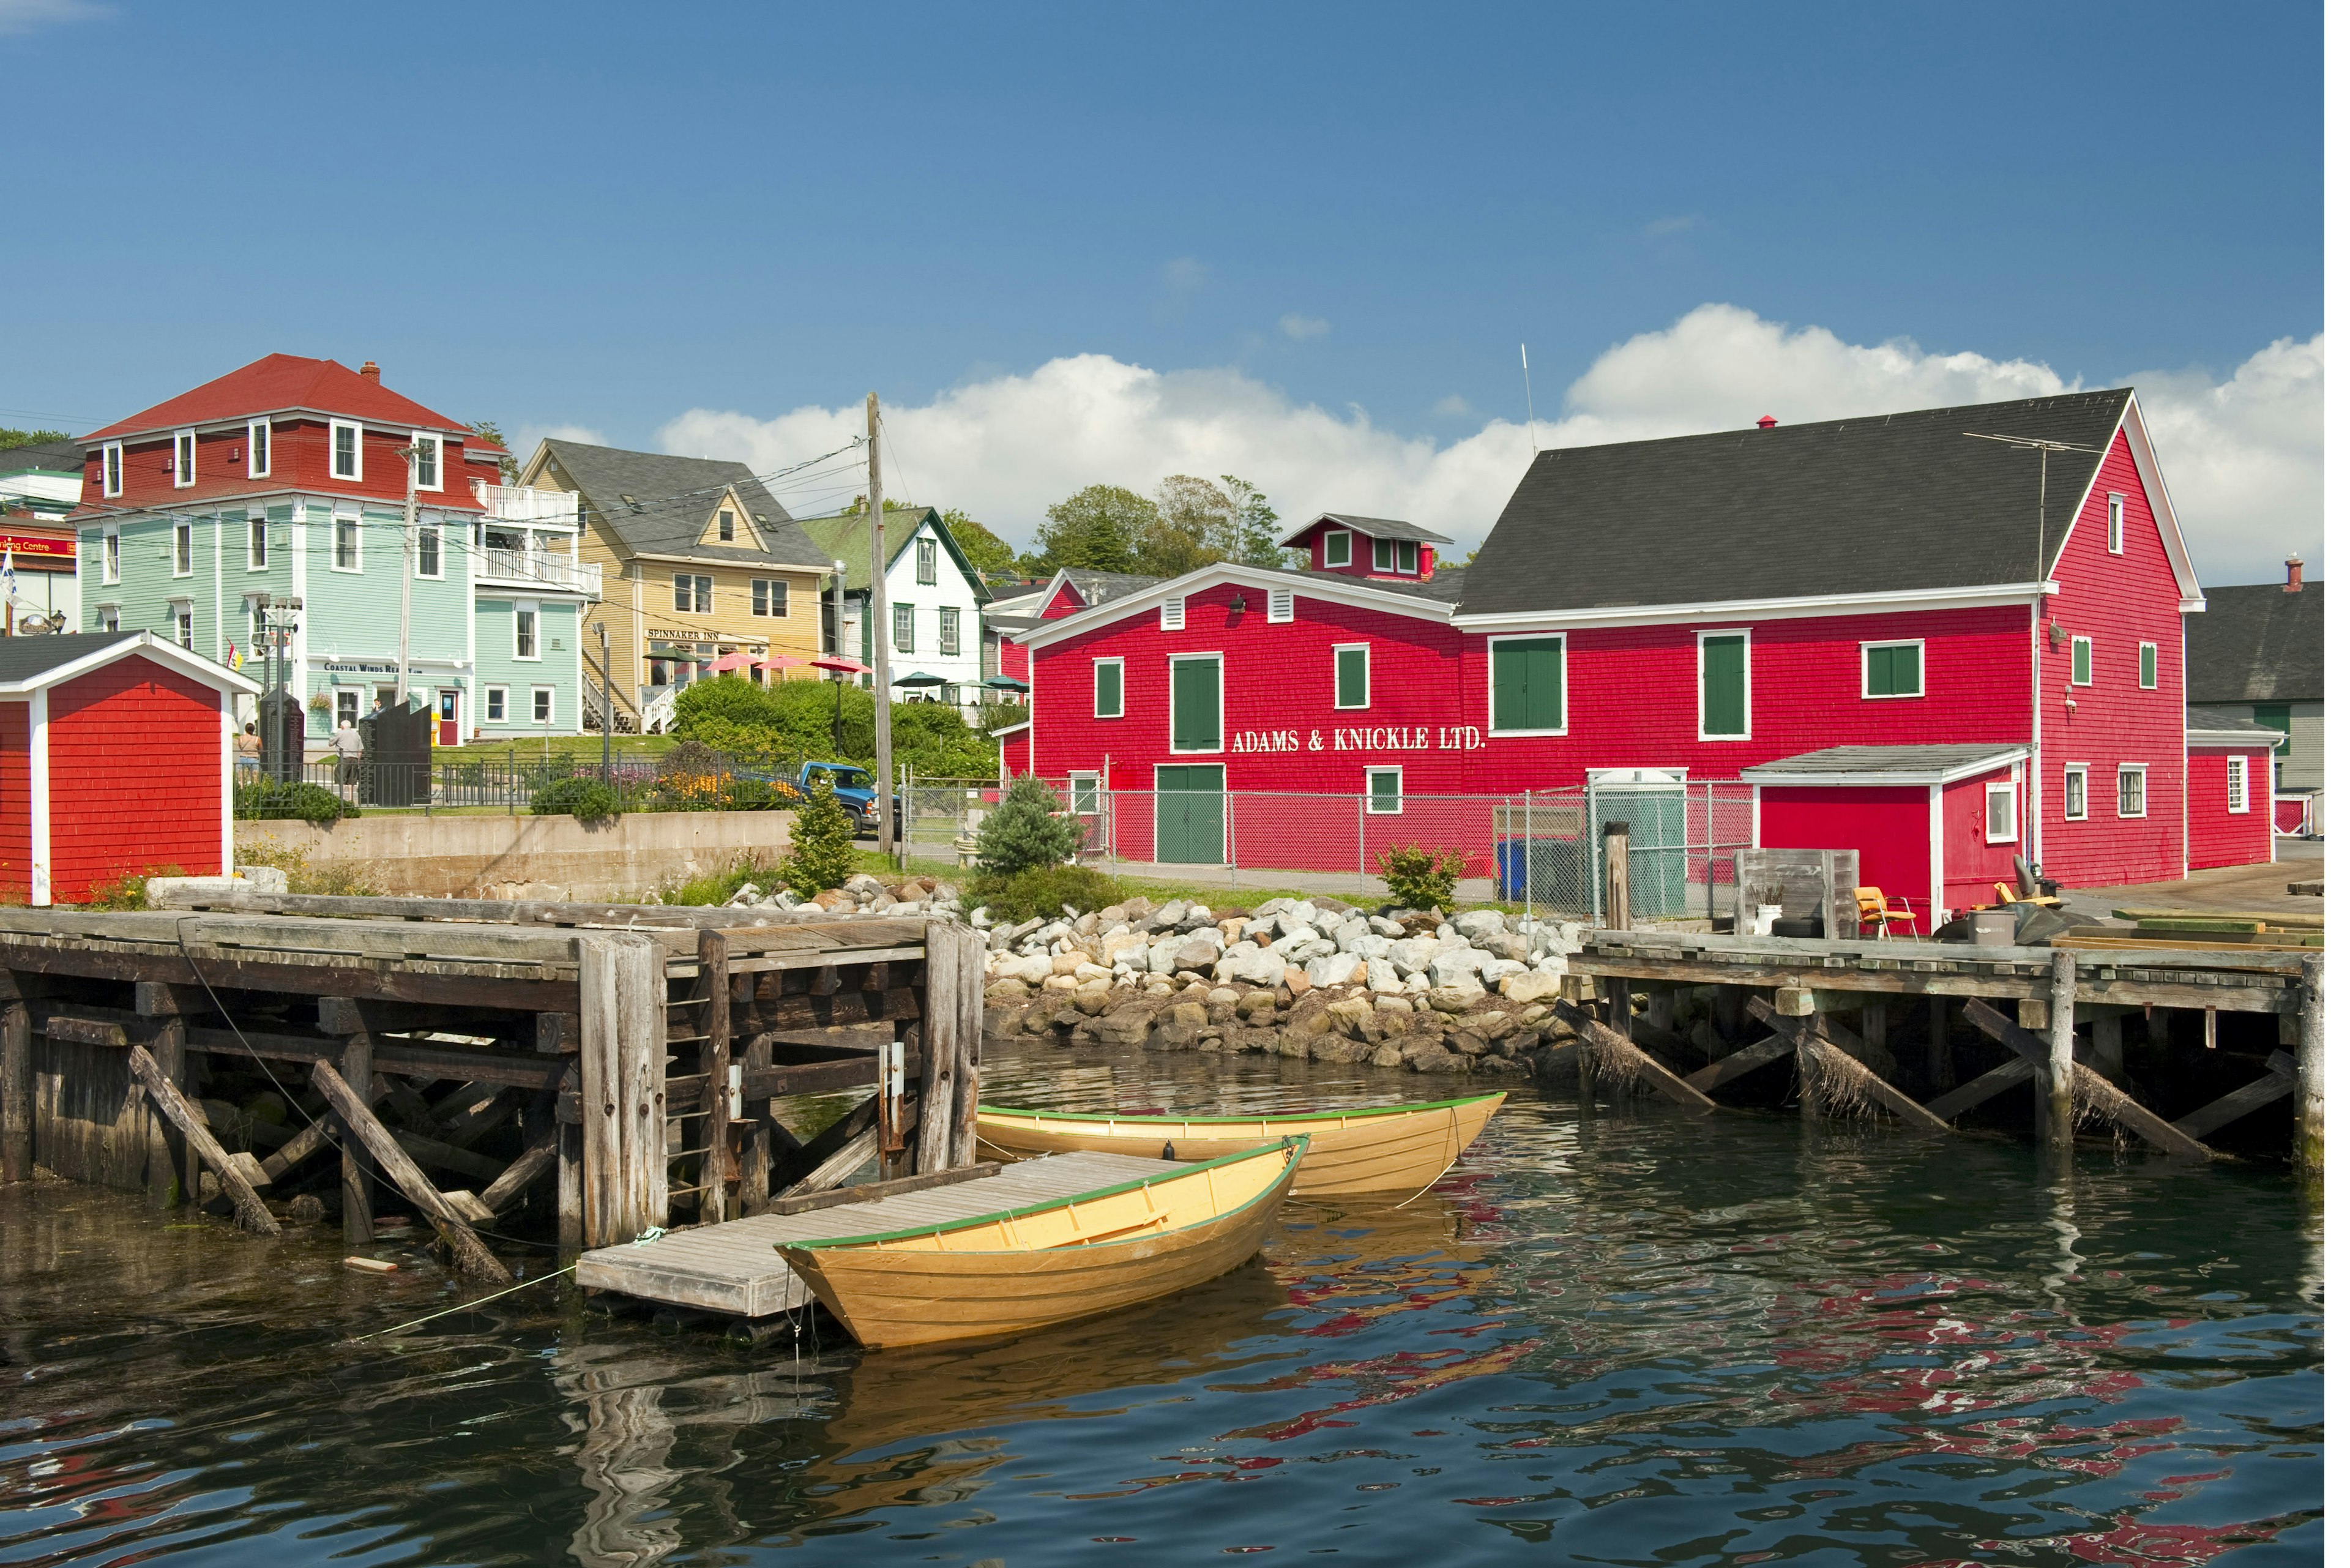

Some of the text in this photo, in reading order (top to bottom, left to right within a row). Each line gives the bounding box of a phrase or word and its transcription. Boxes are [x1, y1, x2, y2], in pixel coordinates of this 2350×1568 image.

[23, 542, 50, 551] Centre
[648, 629, 699, 640] SPINNAKER
[324, 662, 357, 672] COASTAL
[359, 664, 383, 673] WINDS
[385, 665, 412, 674] REAY
[1231, 725, 1486, 753] ADAMS & KNICKLE LTD.
